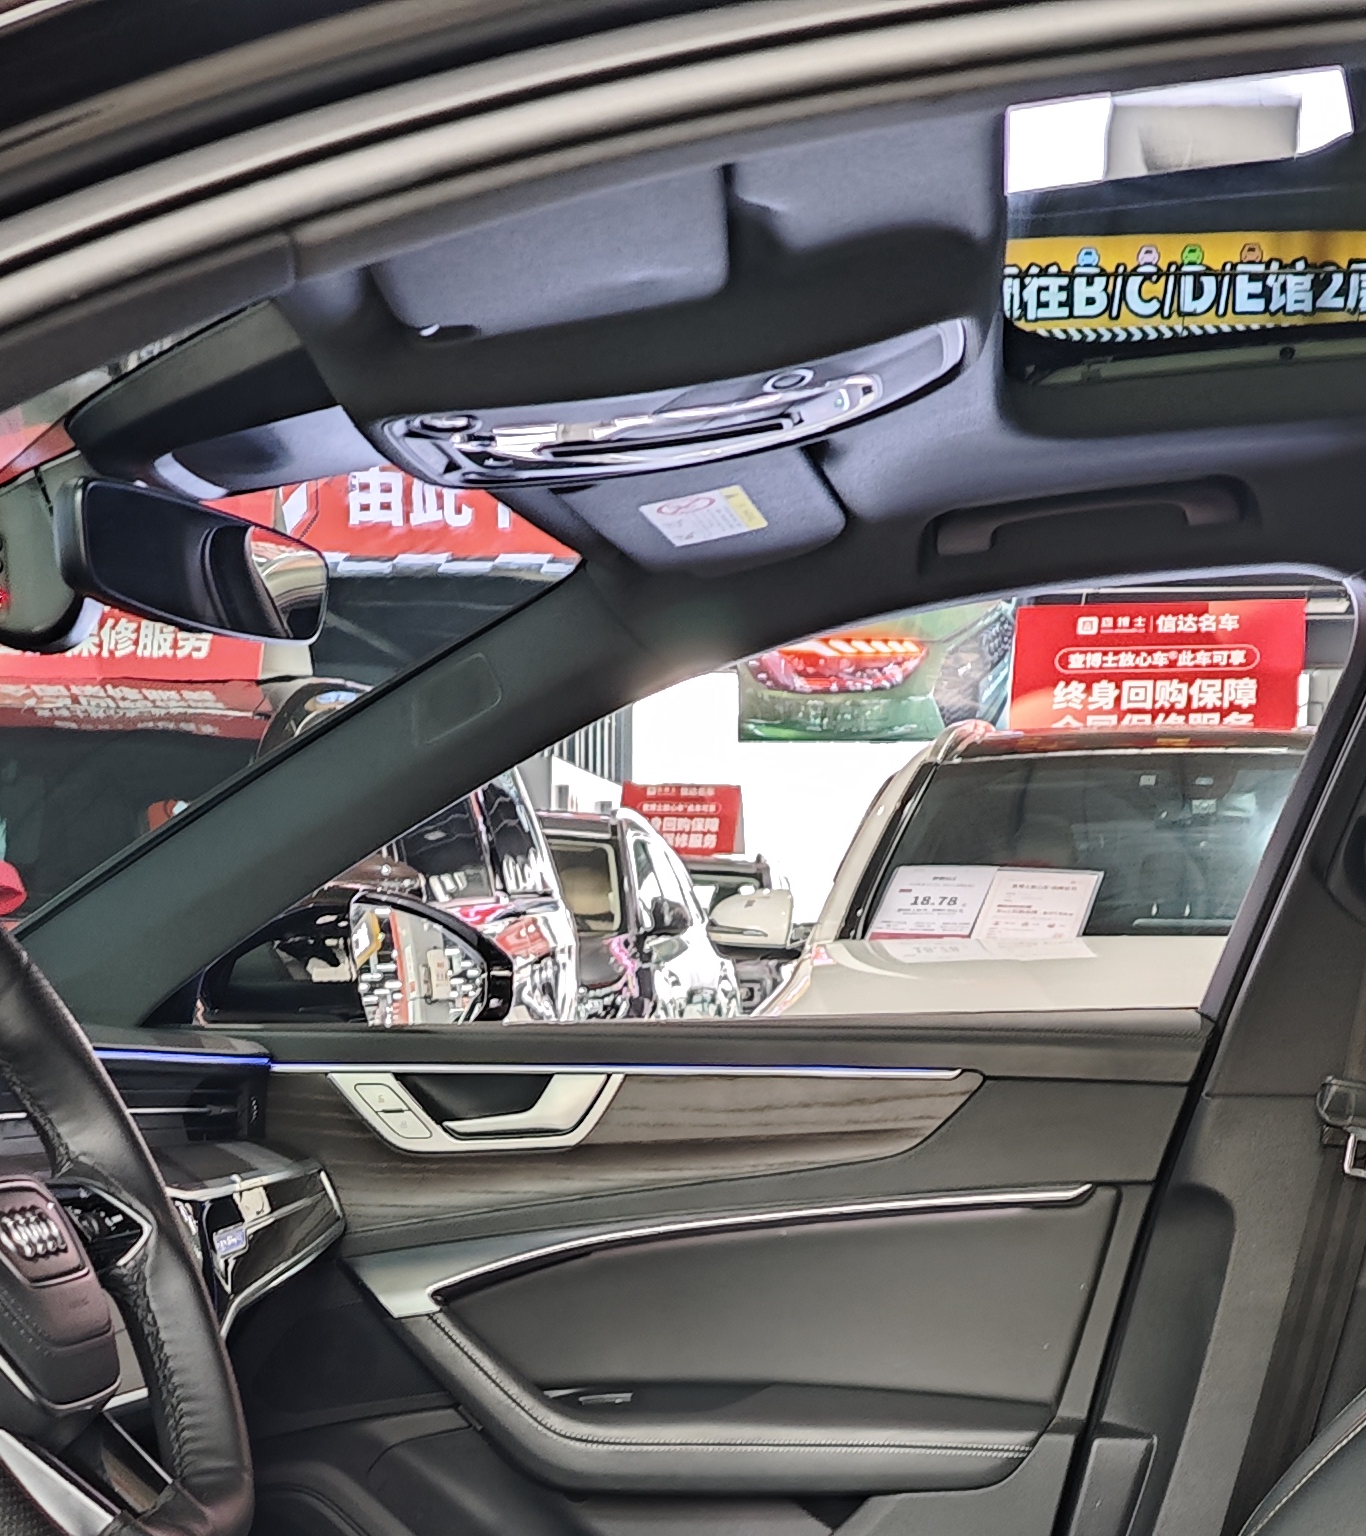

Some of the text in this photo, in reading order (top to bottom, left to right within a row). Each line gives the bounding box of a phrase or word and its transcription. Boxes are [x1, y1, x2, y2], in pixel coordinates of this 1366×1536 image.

[348, 467, 511, 529] 由此
[1156, 614, 1239, 633] 信达名车
[1052, 677, 1257, 710] 终身回购保障
[647, 817, 720, 832] 身回购保障
[910, 896, 958, 906] 18.78
